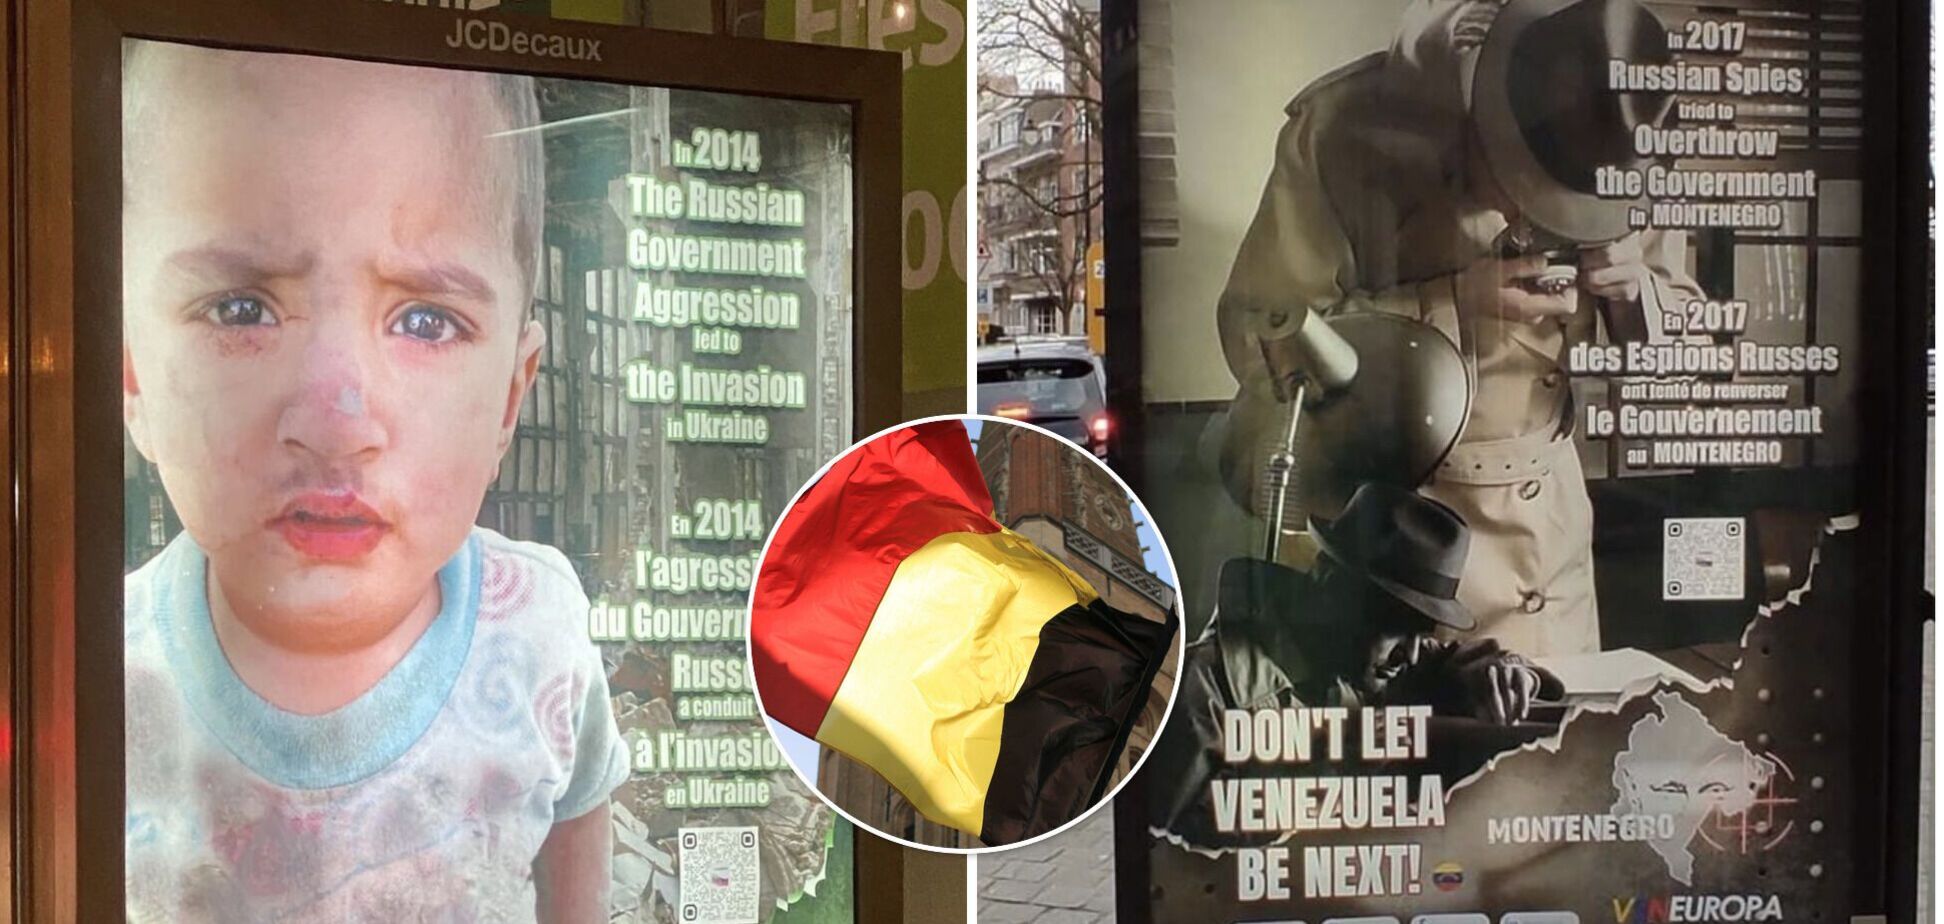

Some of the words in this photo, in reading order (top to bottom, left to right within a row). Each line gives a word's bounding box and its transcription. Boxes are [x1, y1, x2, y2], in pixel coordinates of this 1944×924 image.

[446, 18, 603, 62] JCDecaux
[1686, 20, 1746, 50] 2017
[1608, 59, 1722, 91] Russian
[1726, 61, 1803, 94] Spies
[1678, 101, 1714, 119] tried
[1717, 104, 1734, 120] to
[693, 129, 761, 171] 2014
[1634, 124, 1778, 155] Overthrow
[1595, 166, 1643, 196] the
[1649, 166, 1816, 197] Government
[630, 177, 683, 217] The
[689, 179, 804, 225] Russian
[1652, 203, 1783, 227] MONTENEGRO
[629, 229, 806, 277] Government
[635, 281, 799, 328] Aggression
[1664, 311, 1682, 331] En
[1685, 302, 1747, 332] 2017
[694, 329, 721, 352] led
[722, 331, 741, 352] to
[1569, 343, 1621, 373] des
[1626, 341, 1734, 374] Espions
[1739, 342, 1840, 372] Russes
[627, 364, 676, 401] the
[681, 364, 806, 407] Invasion
[1621, 384, 1647, 400] ont
[1650, 381, 1690, 400] tenté
[1692, 382, 1712, 400] de
[1713, 384, 1789, 401] renverser
[667, 417, 684, 438] in
[686, 413, 768, 443] Ukraine
[1586, 404, 1614, 436] le
[1619, 404, 1823, 436] Gouvernement
[1627, 449, 1647, 466] au
[1653, 441, 1782, 465] MONTENEGRO
[671, 515, 690, 536] En
[693, 501, 763, 539] 2014
[590, 605, 627, 639] du
[679, 700, 690, 718] a
[692, 698, 755, 718] conduit
[1224, 708, 1348, 763] DON'T
[1361, 705, 1433, 760] LET
[634, 736, 657, 769] à
[666, 786, 685, 804] en
[687, 779, 769, 808] Ukraine
[1210, 774, 1446, 833] VENEZUELA
[1487, 813, 1676, 844] MONTENEGRO
[1237, 847, 1291, 901] BE
[1303, 845, 1422, 899] NEXT!
